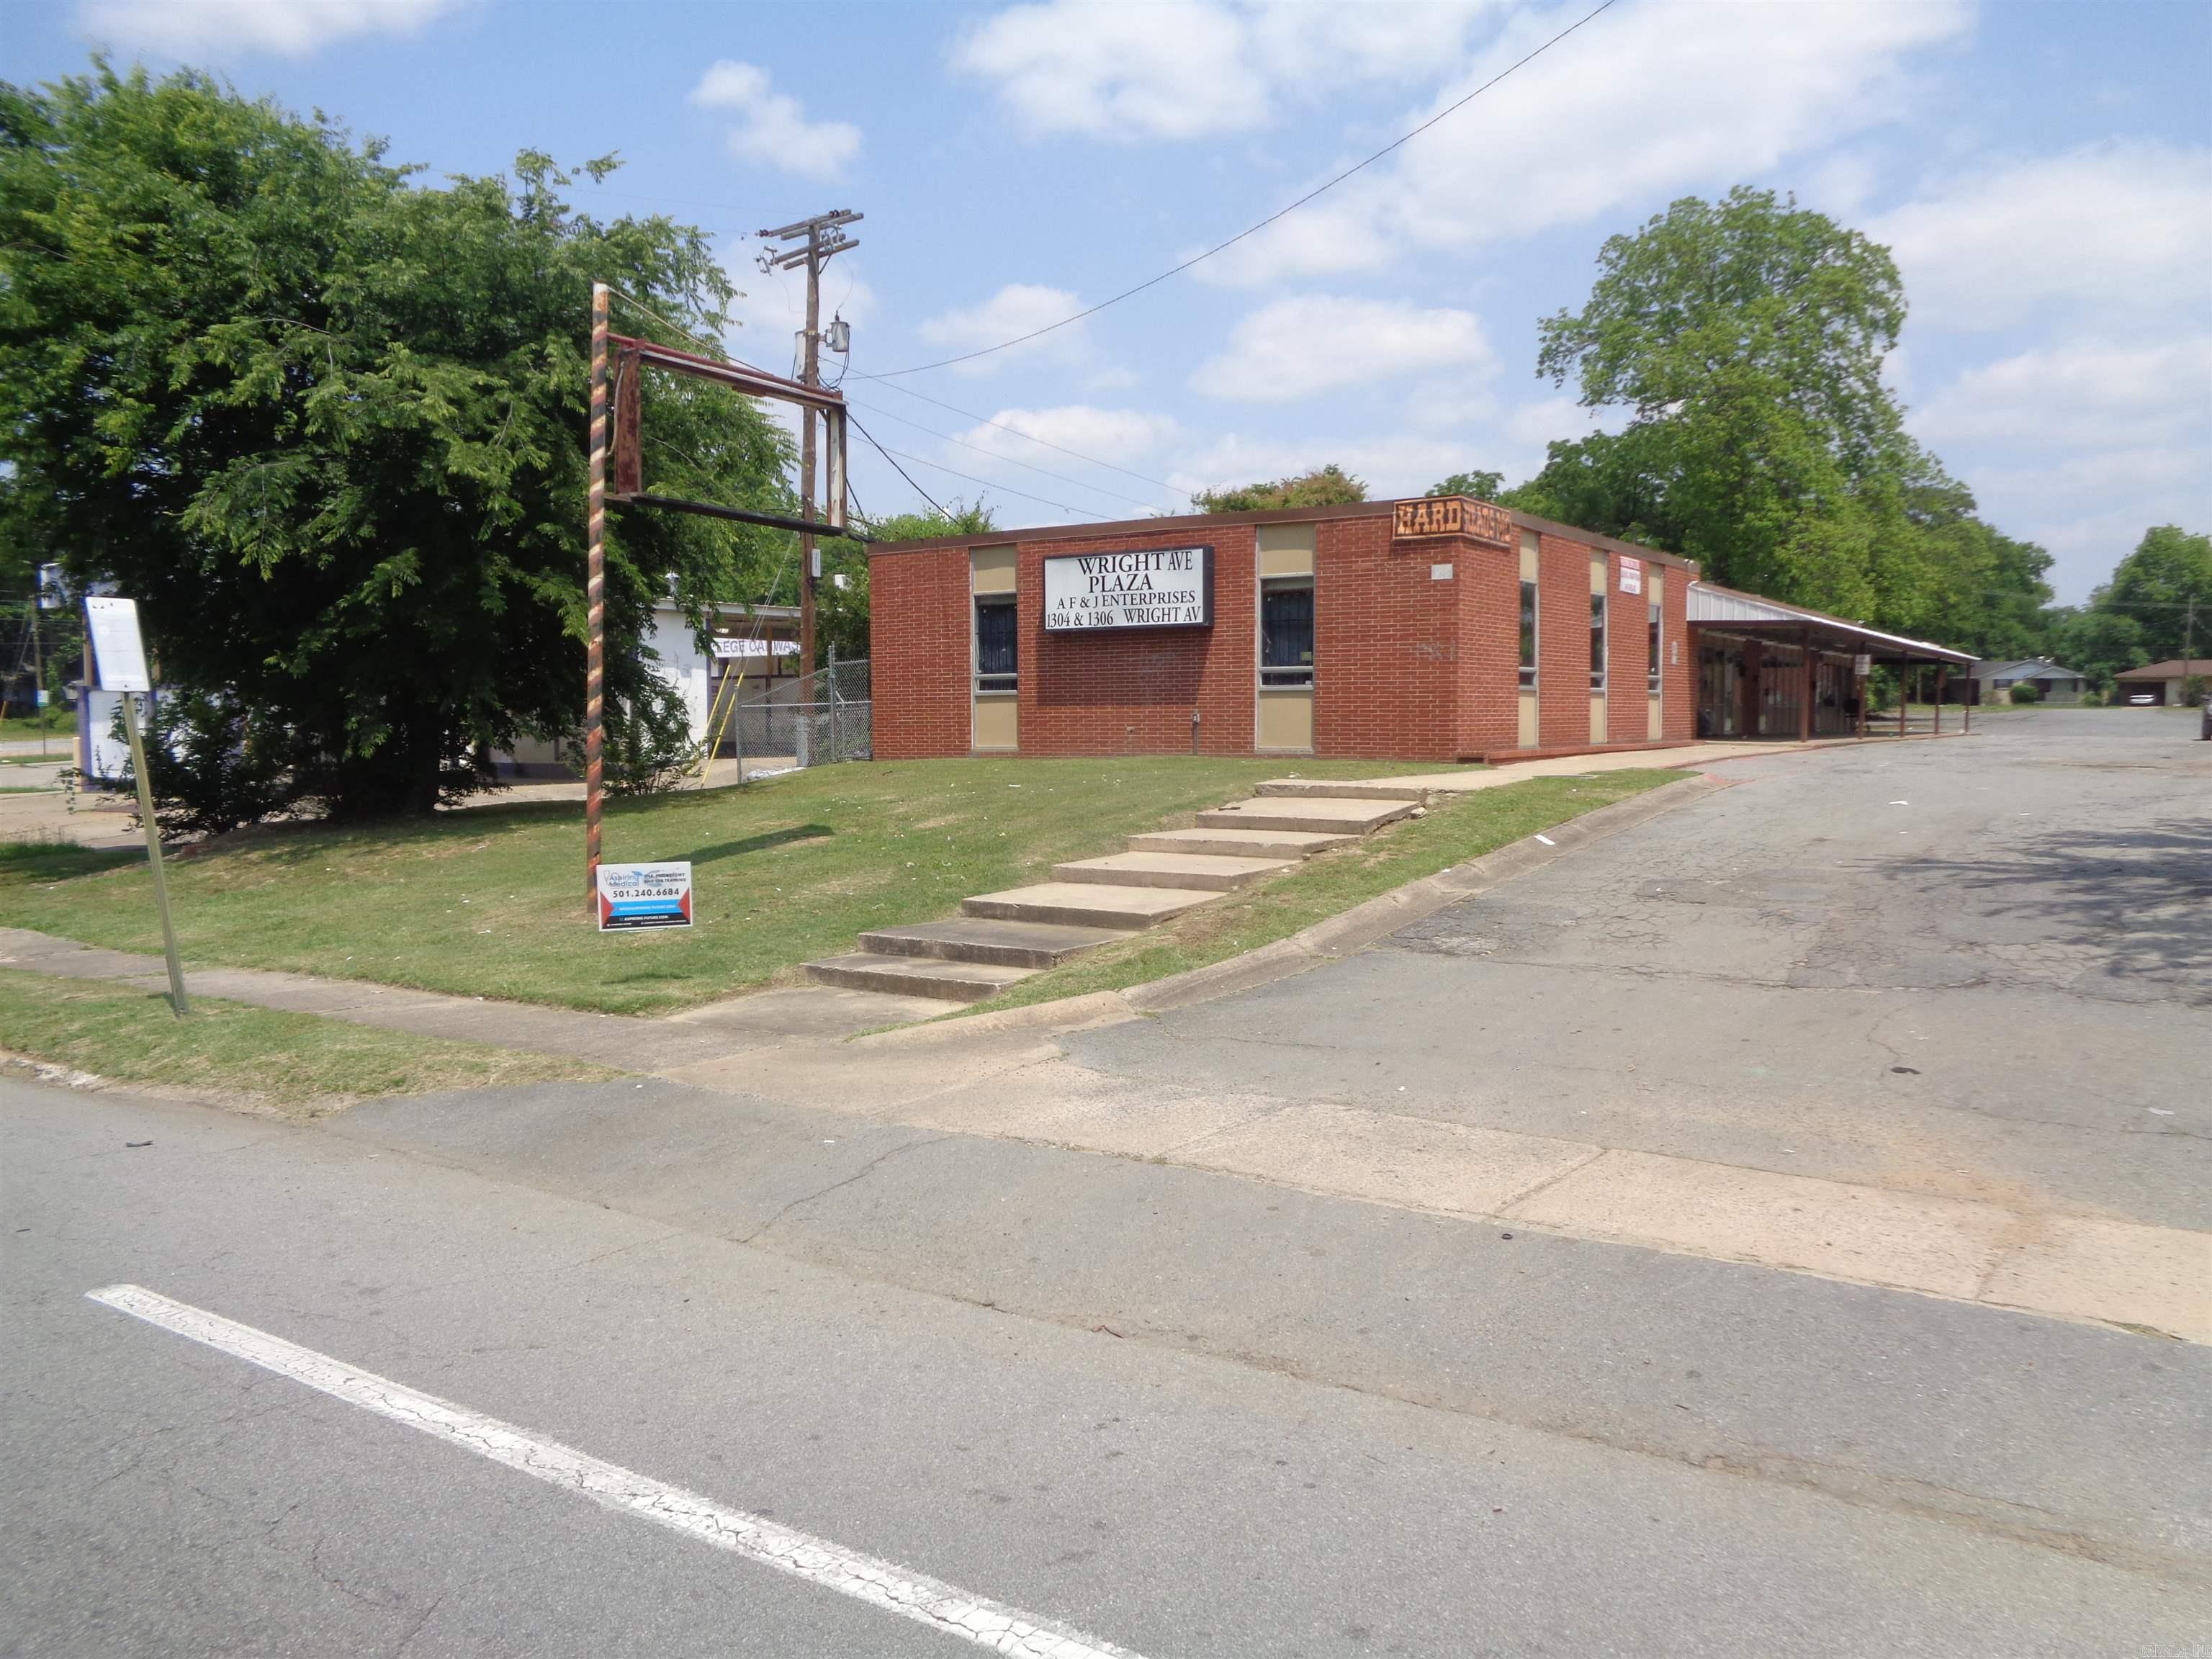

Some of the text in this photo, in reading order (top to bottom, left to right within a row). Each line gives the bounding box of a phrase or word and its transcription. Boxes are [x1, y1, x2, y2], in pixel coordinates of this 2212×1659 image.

[1397, 500, 1462, 535] HARD
[1077, 551, 1193, 575] WRIGHT AVE
[1088, 573, 1154, 593] PLAZA
[1057, 590, 1196, 610] A F & J ENTERPRISES
[1047, 606, 1202, 628] 1304 & 1306 WRIGHT AV
[613, 888, 680, 898] 501.240.6684
